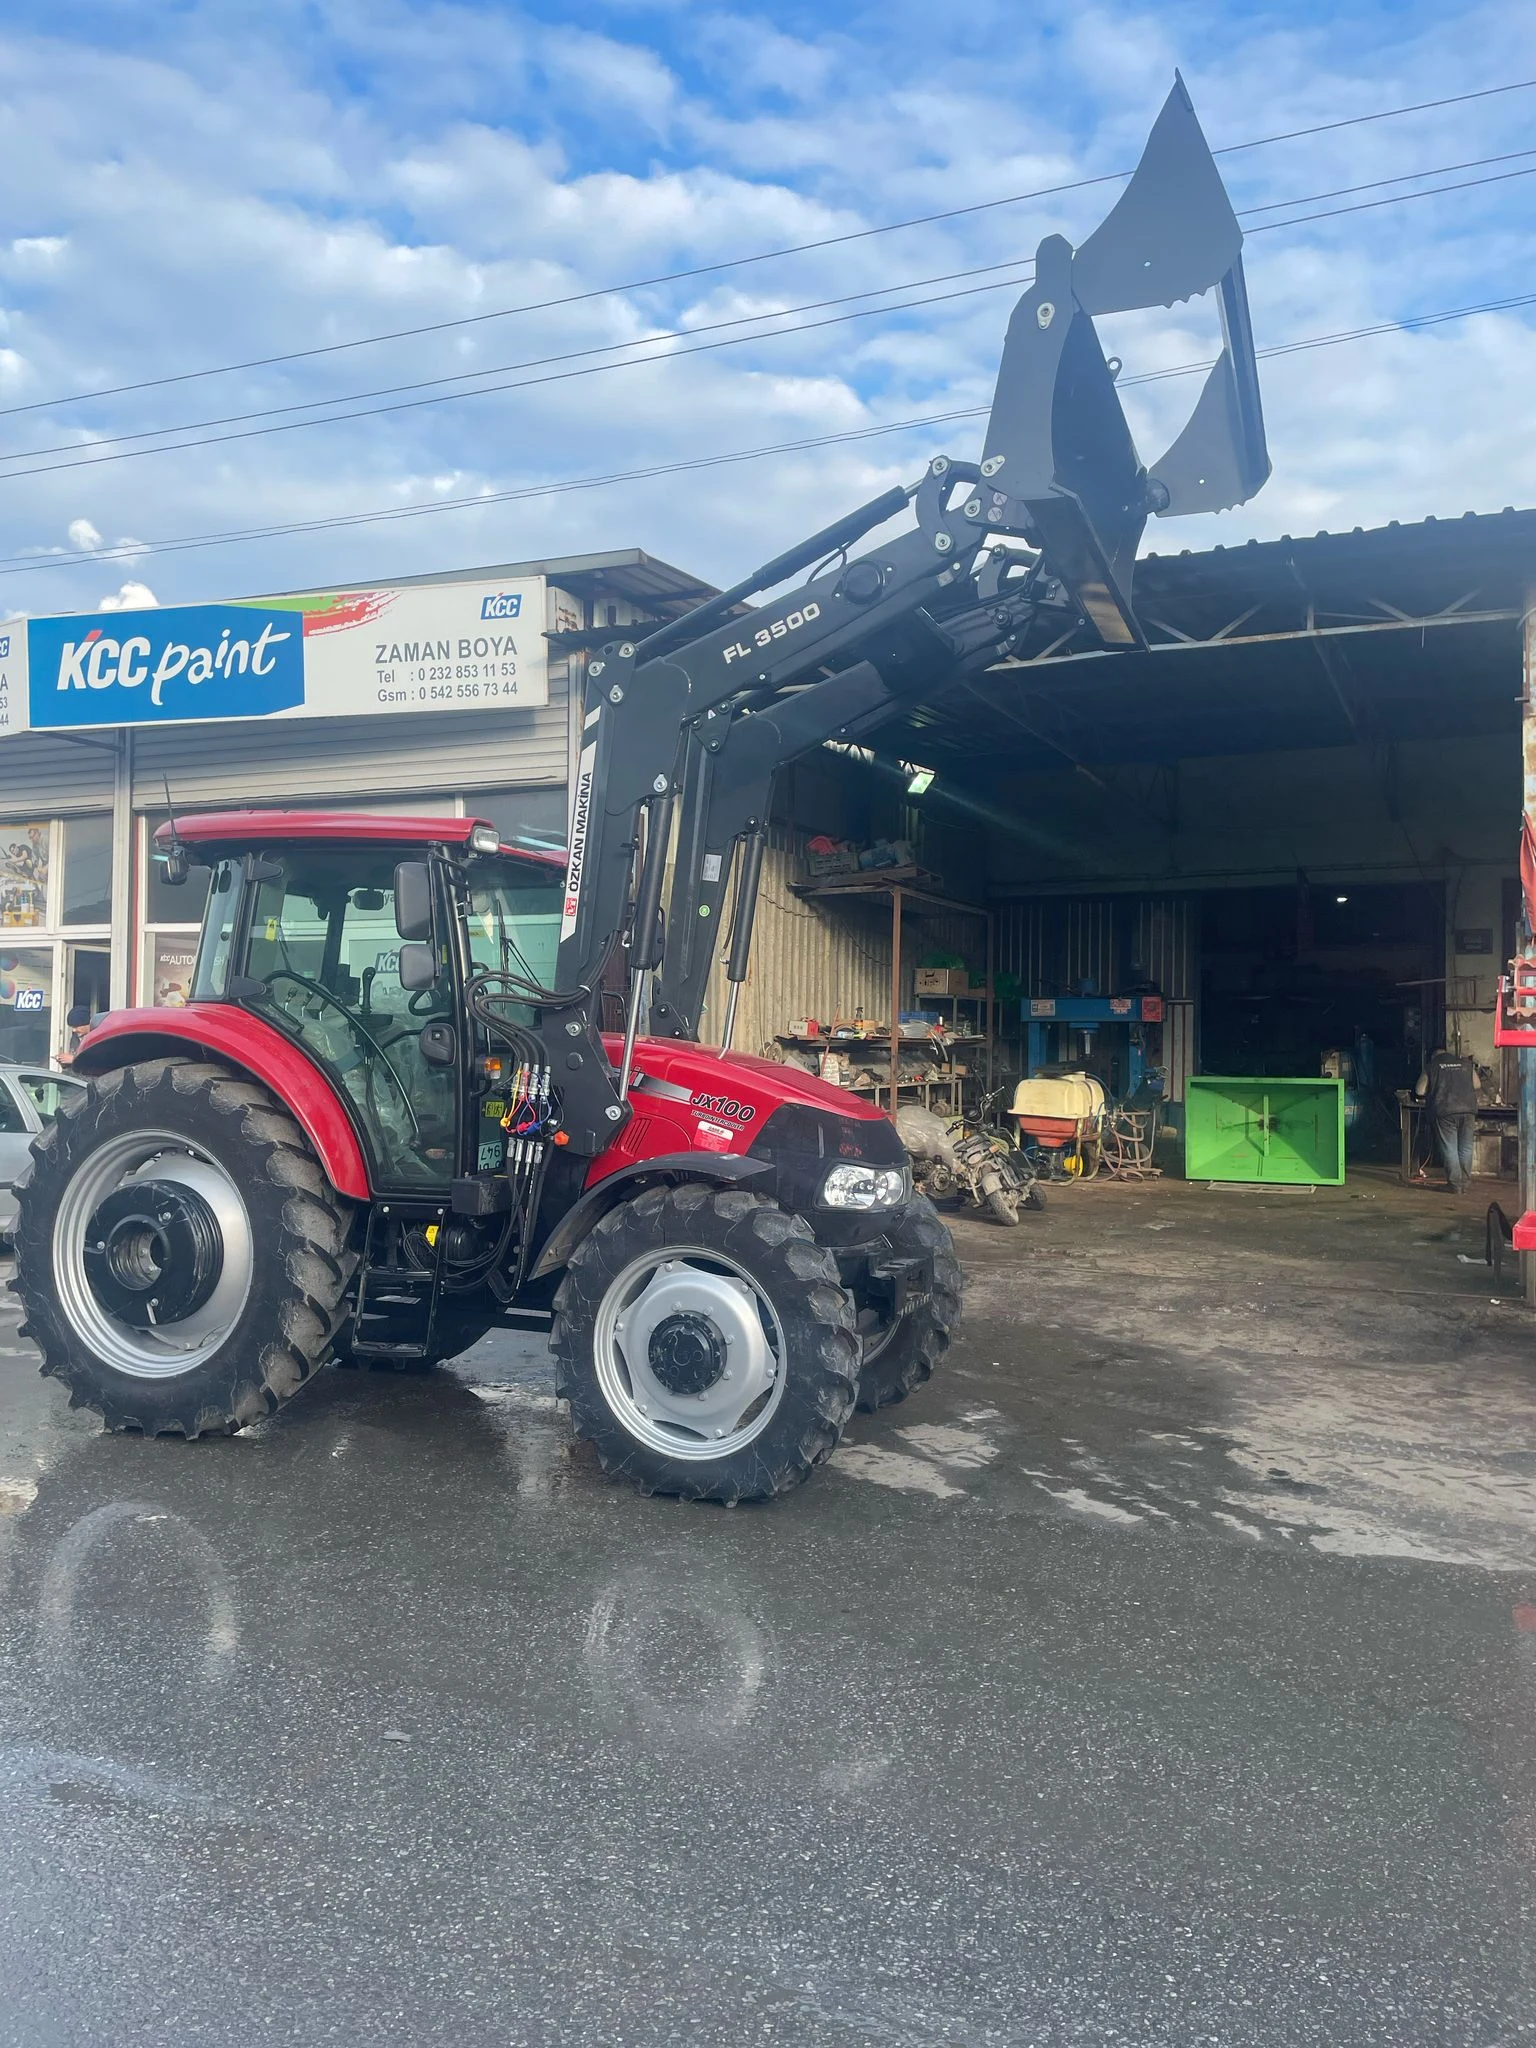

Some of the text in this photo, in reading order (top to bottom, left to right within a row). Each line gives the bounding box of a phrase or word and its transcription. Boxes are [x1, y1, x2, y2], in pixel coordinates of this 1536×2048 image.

[485, 593, 518, 617] KCC
[722, 602, 820, 665] FL 3500
[56, 622, 291, 706] KCC paint
[375, 635, 518, 664] ZAMAN BOYA
[377, 669, 395, 683] Tel
[418, 667, 425, 681] 0
[429, 666, 452, 681] 232
[456, 664, 479, 679] 853
[483, 663, 496, 677] 11
[501, 662, 516, 676] 53
[377, 689, 407, 702] Gsm
[419, 687, 426, 700] 0
[430, 685, 453, 699] 542
[457, 684, 479, 698] 556
[483, 683, 498, 696] 73
[502, 681, 518, 695] 44
[568, 838, 584, 892] ÖZKAN
[576, 772, 592, 834] MAKİNA
[17, 988, 41, 1009] KCC
[692, 1093, 756, 1122] JX100
